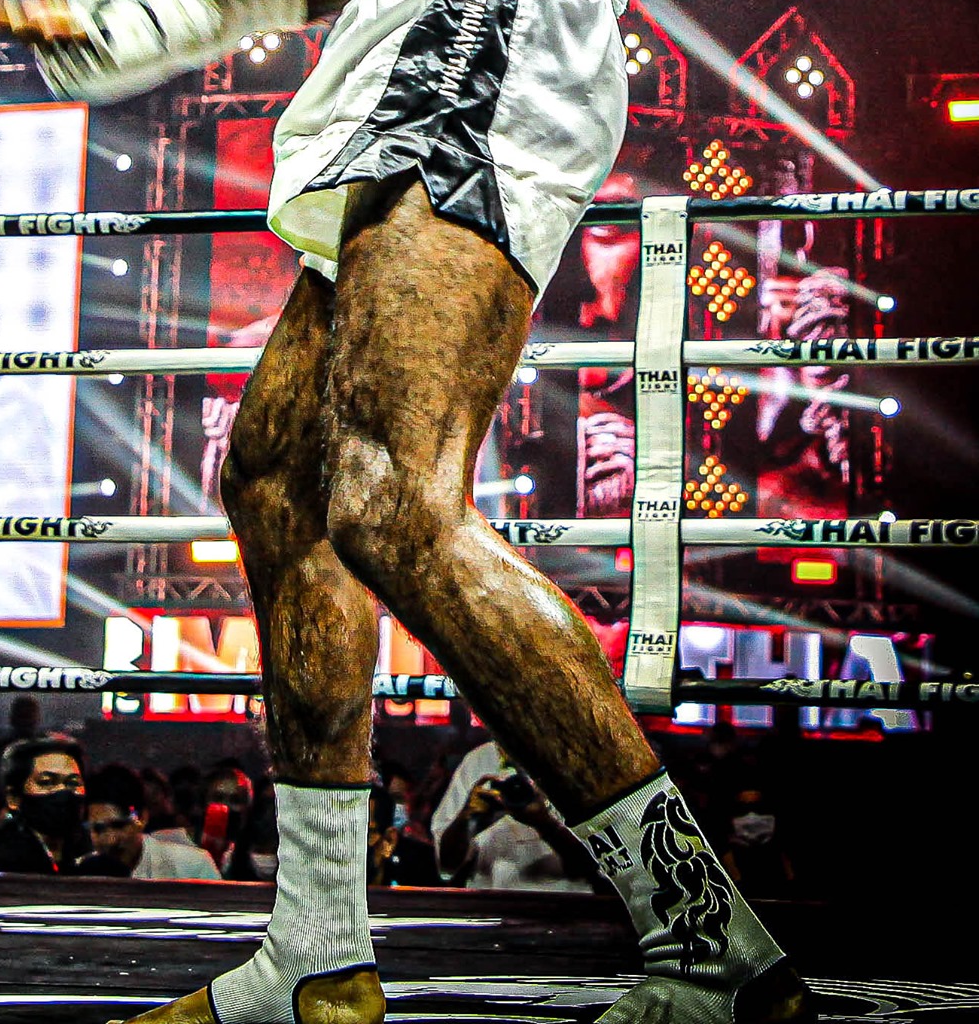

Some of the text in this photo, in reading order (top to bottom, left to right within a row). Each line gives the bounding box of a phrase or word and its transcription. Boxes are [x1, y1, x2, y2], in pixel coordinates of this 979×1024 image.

[822, 188, 979, 211] THAI FIG
[18, 212, 116, 234] FIGHT
[644, 243, 683, 255] THAI
[790, 336, 979, 360] THAI FIGH
[638, 370, 678, 382] THAI
[637, 500, 677, 511] THAI
[800, 519, 977, 544] THAI FIG
[632, 633, 674, 645] THAI
[805, 679, 979, 702] THAI FIG
